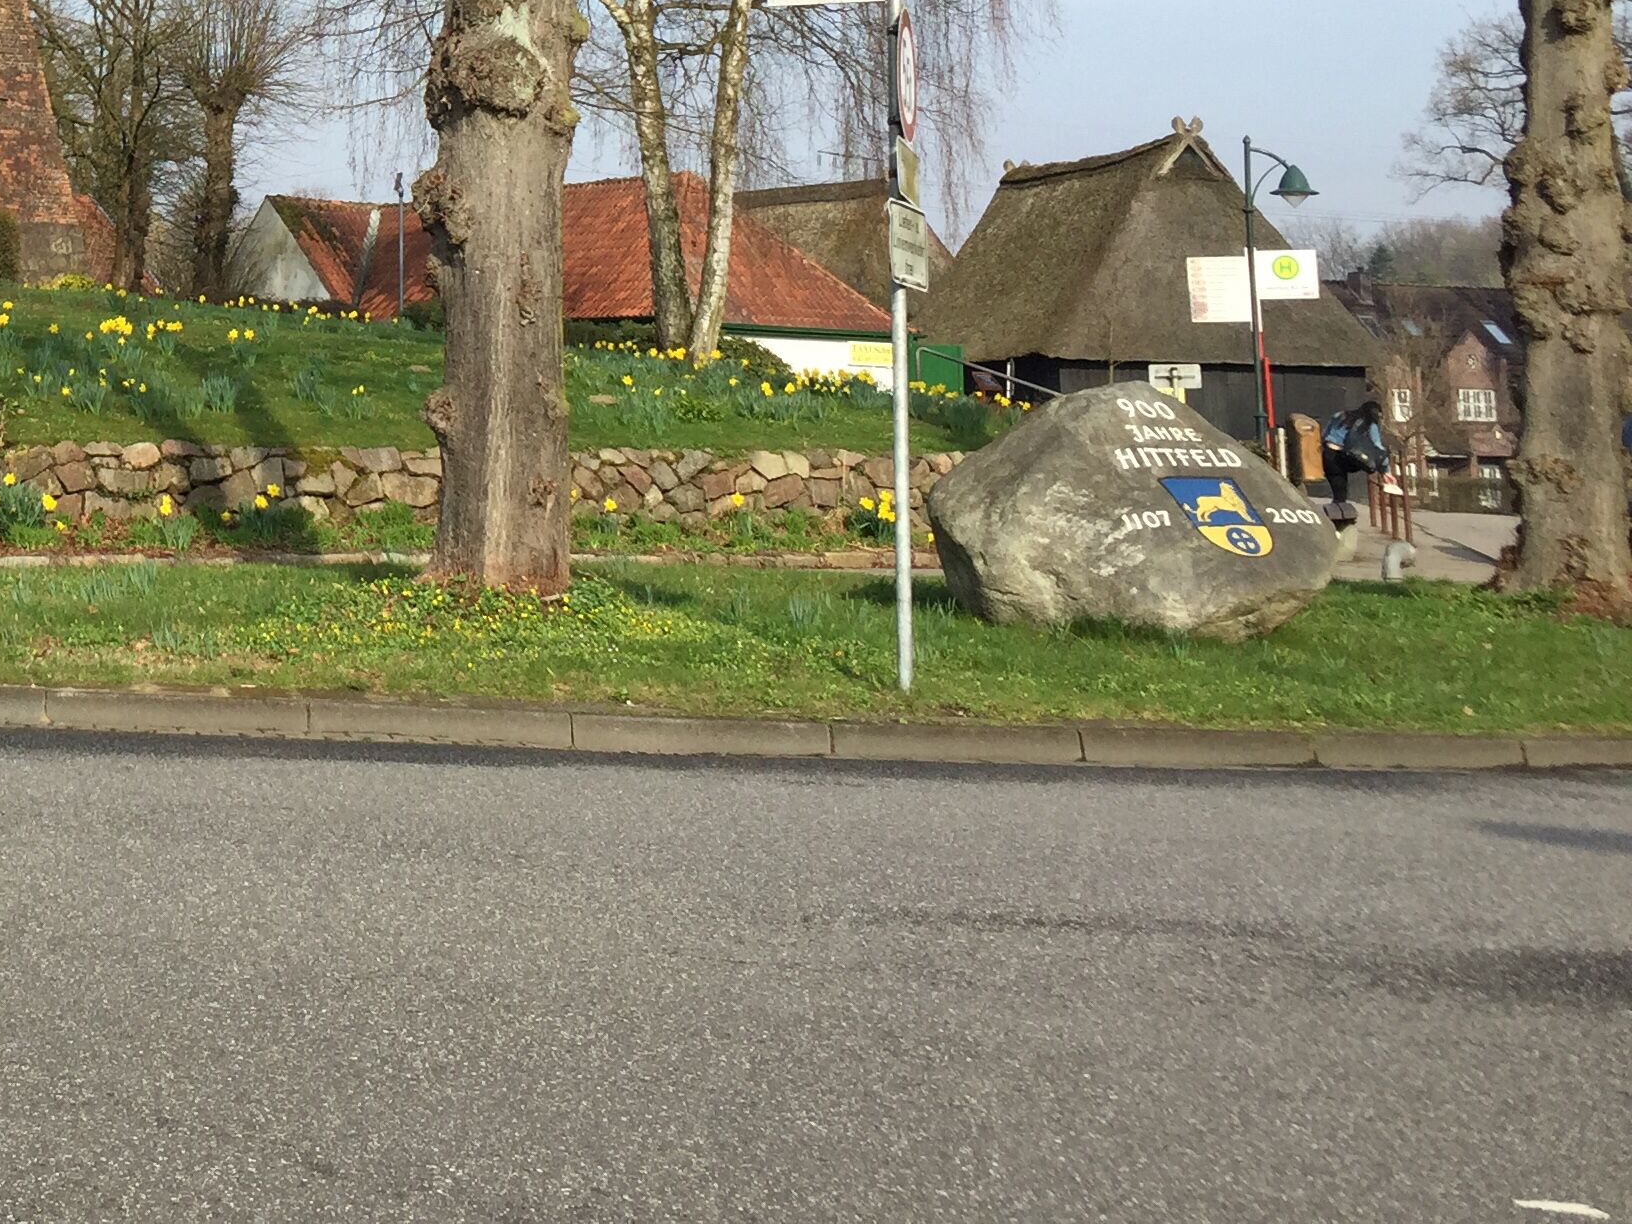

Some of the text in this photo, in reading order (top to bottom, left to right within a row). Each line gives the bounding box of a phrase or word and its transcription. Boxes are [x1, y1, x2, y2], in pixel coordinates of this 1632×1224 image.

[1279, 261, 1292, 273] H
[1116, 398, 1176, 420] 900
[1125, 424, 1203, 443] JAHRE
[1114, 447, 1242, 469] HITTFELD
[1121, 510, 1171, 531] 1107
[1266, 508, 1322, 525] 2007
